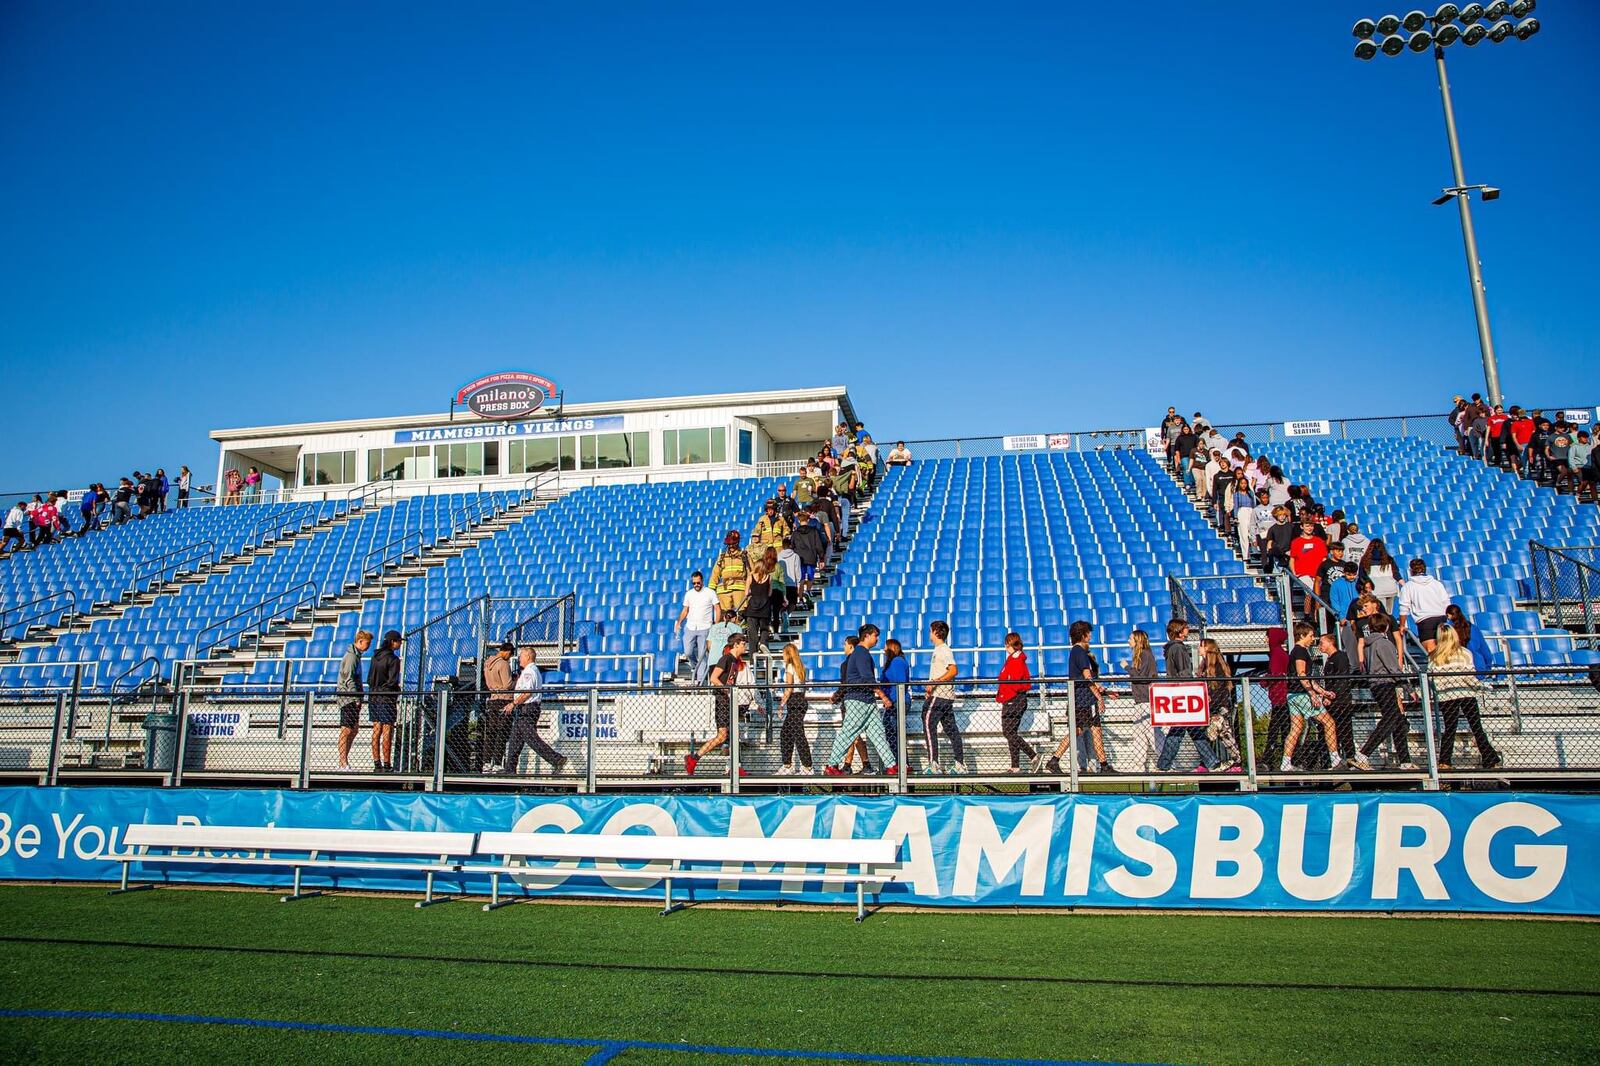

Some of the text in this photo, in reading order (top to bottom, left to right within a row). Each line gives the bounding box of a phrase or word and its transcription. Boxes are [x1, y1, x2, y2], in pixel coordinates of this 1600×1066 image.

[476, 387, 536, 403] milano's
[480, 401, 530, 412] PRESS BOX
[1292, 421, 1321, 429] GENERAL
[411, 420, 595, 442] MIAMISBURG VIKINGS
[1293, 427, 1321, 435] SEATING
[1050, 437, 1068, 446] RED
[1155, 695, 1204, 713] RED
[191, 725, 234, 736] SEATING
[566, 726, 618, 737] SEAING
[717, 801, 1568, 903] MIAMISBURG
